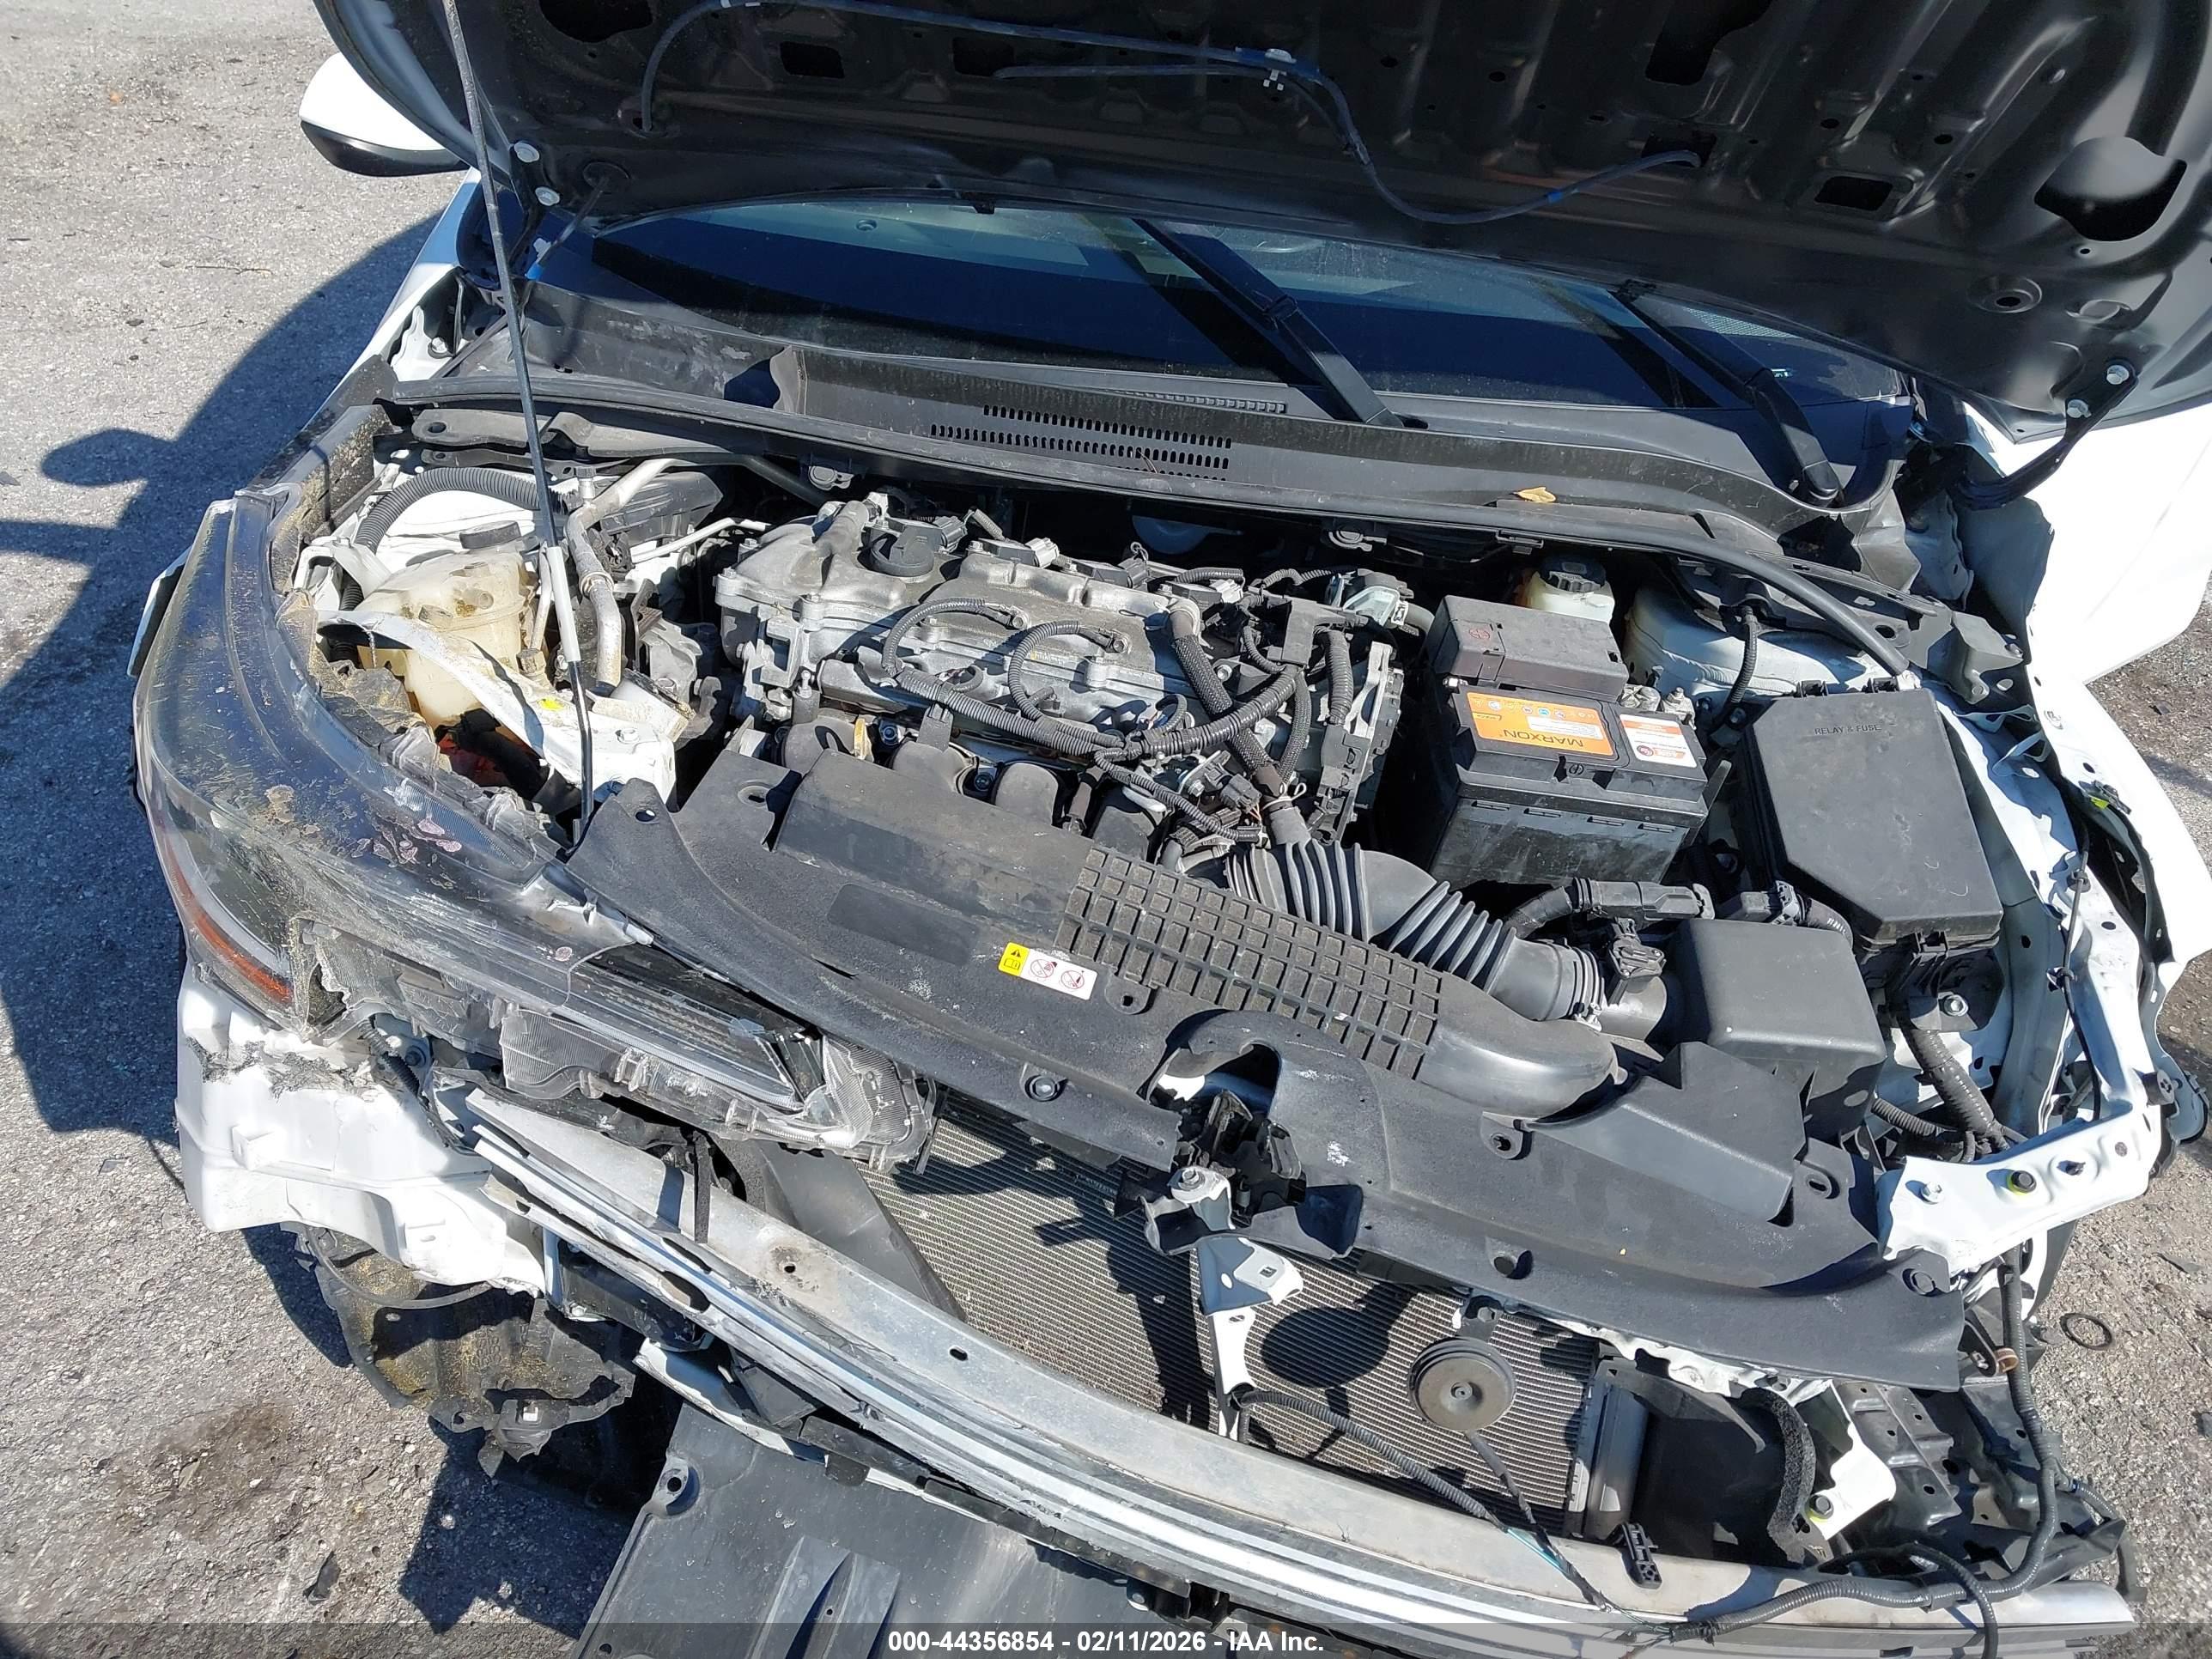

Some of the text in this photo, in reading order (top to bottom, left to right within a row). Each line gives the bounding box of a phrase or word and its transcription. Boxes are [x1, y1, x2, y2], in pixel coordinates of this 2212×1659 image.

[1814, 726, 1844, 735] RELAY
[1856, 724, 1882, 732] FUSE
[1503, 729, 1584, 747] MARXON
